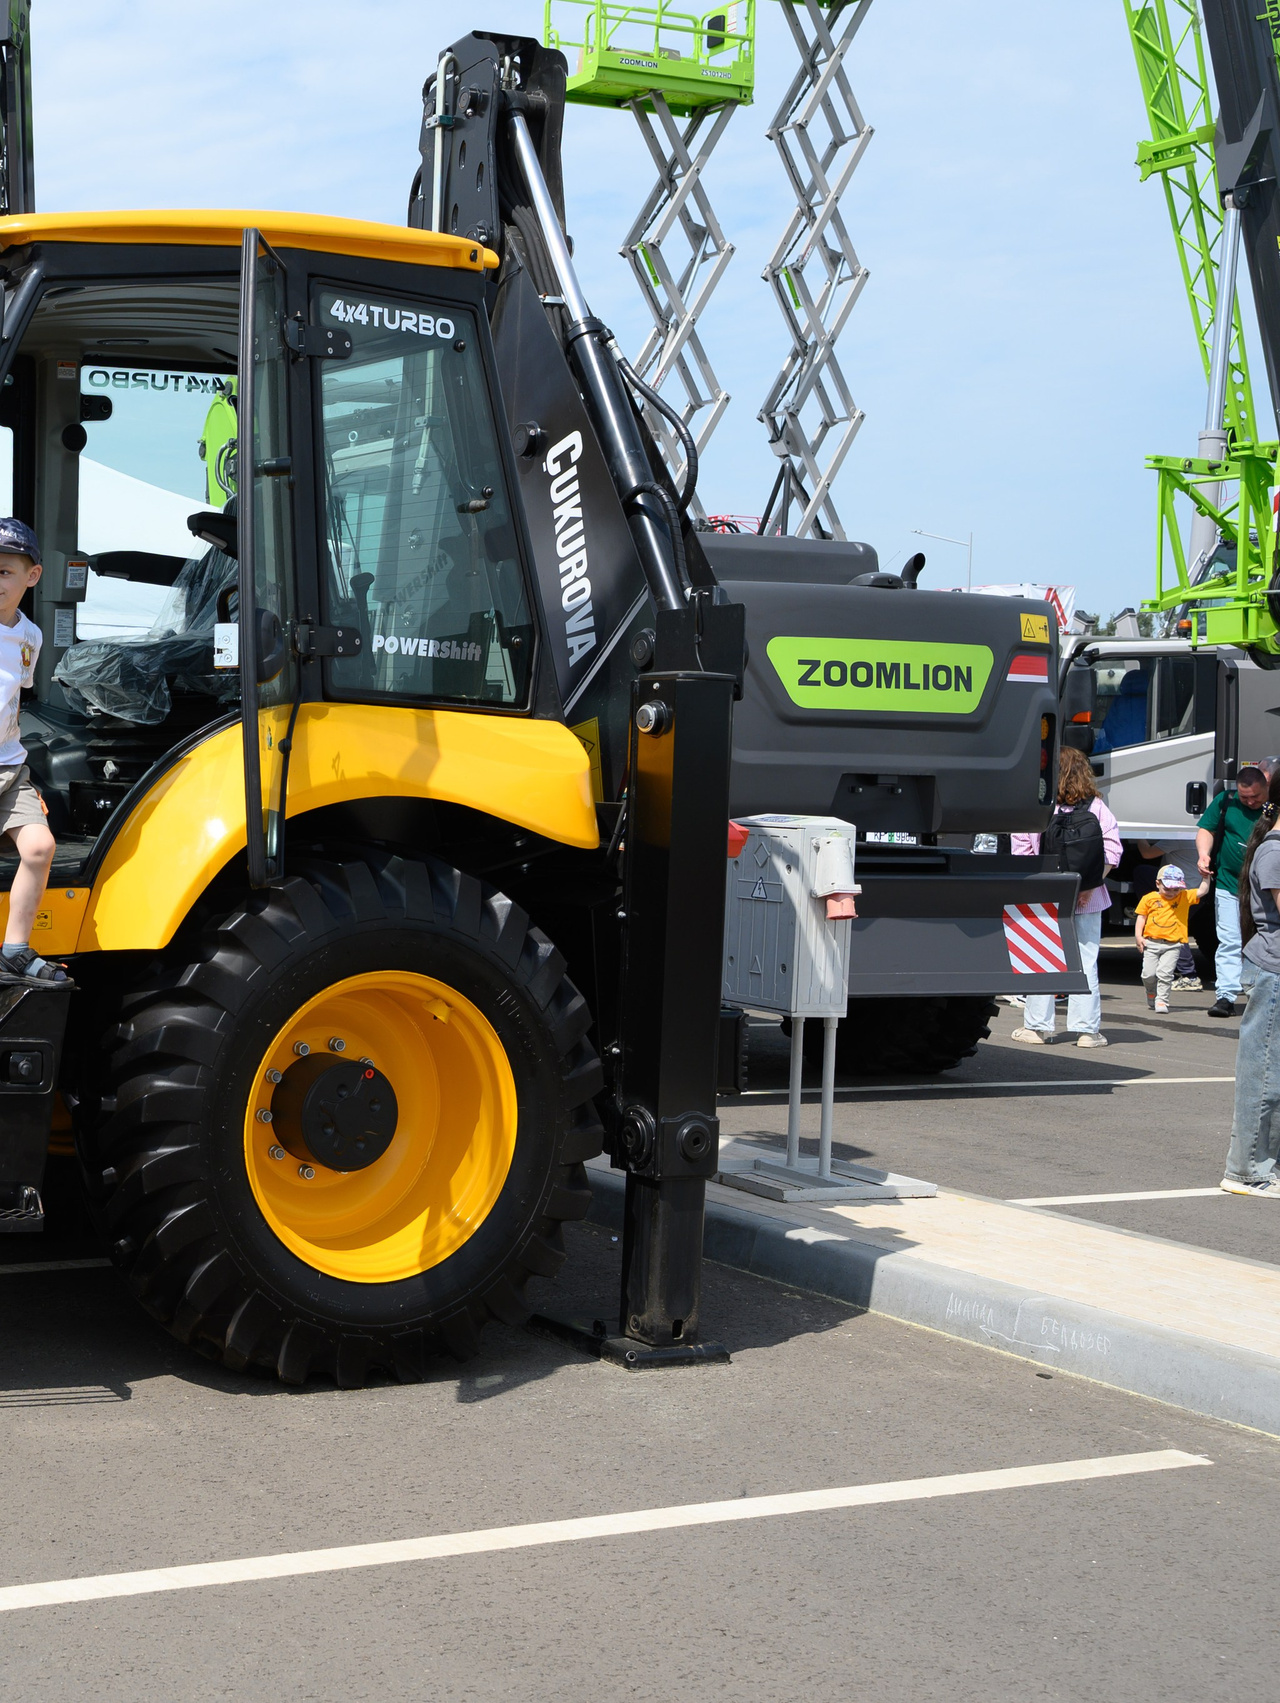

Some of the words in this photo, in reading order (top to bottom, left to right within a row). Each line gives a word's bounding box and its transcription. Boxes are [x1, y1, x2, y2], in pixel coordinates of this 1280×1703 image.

[619, 57, 658, 69] ZOOMLION
[330, 299, 455, 340] 4x4TURBO
[542, 430, 597, 668] ÇUKUROVA
[372, 634, 482, 662] POWERShift
[797, 659, 973, 693] ZOOMLION
